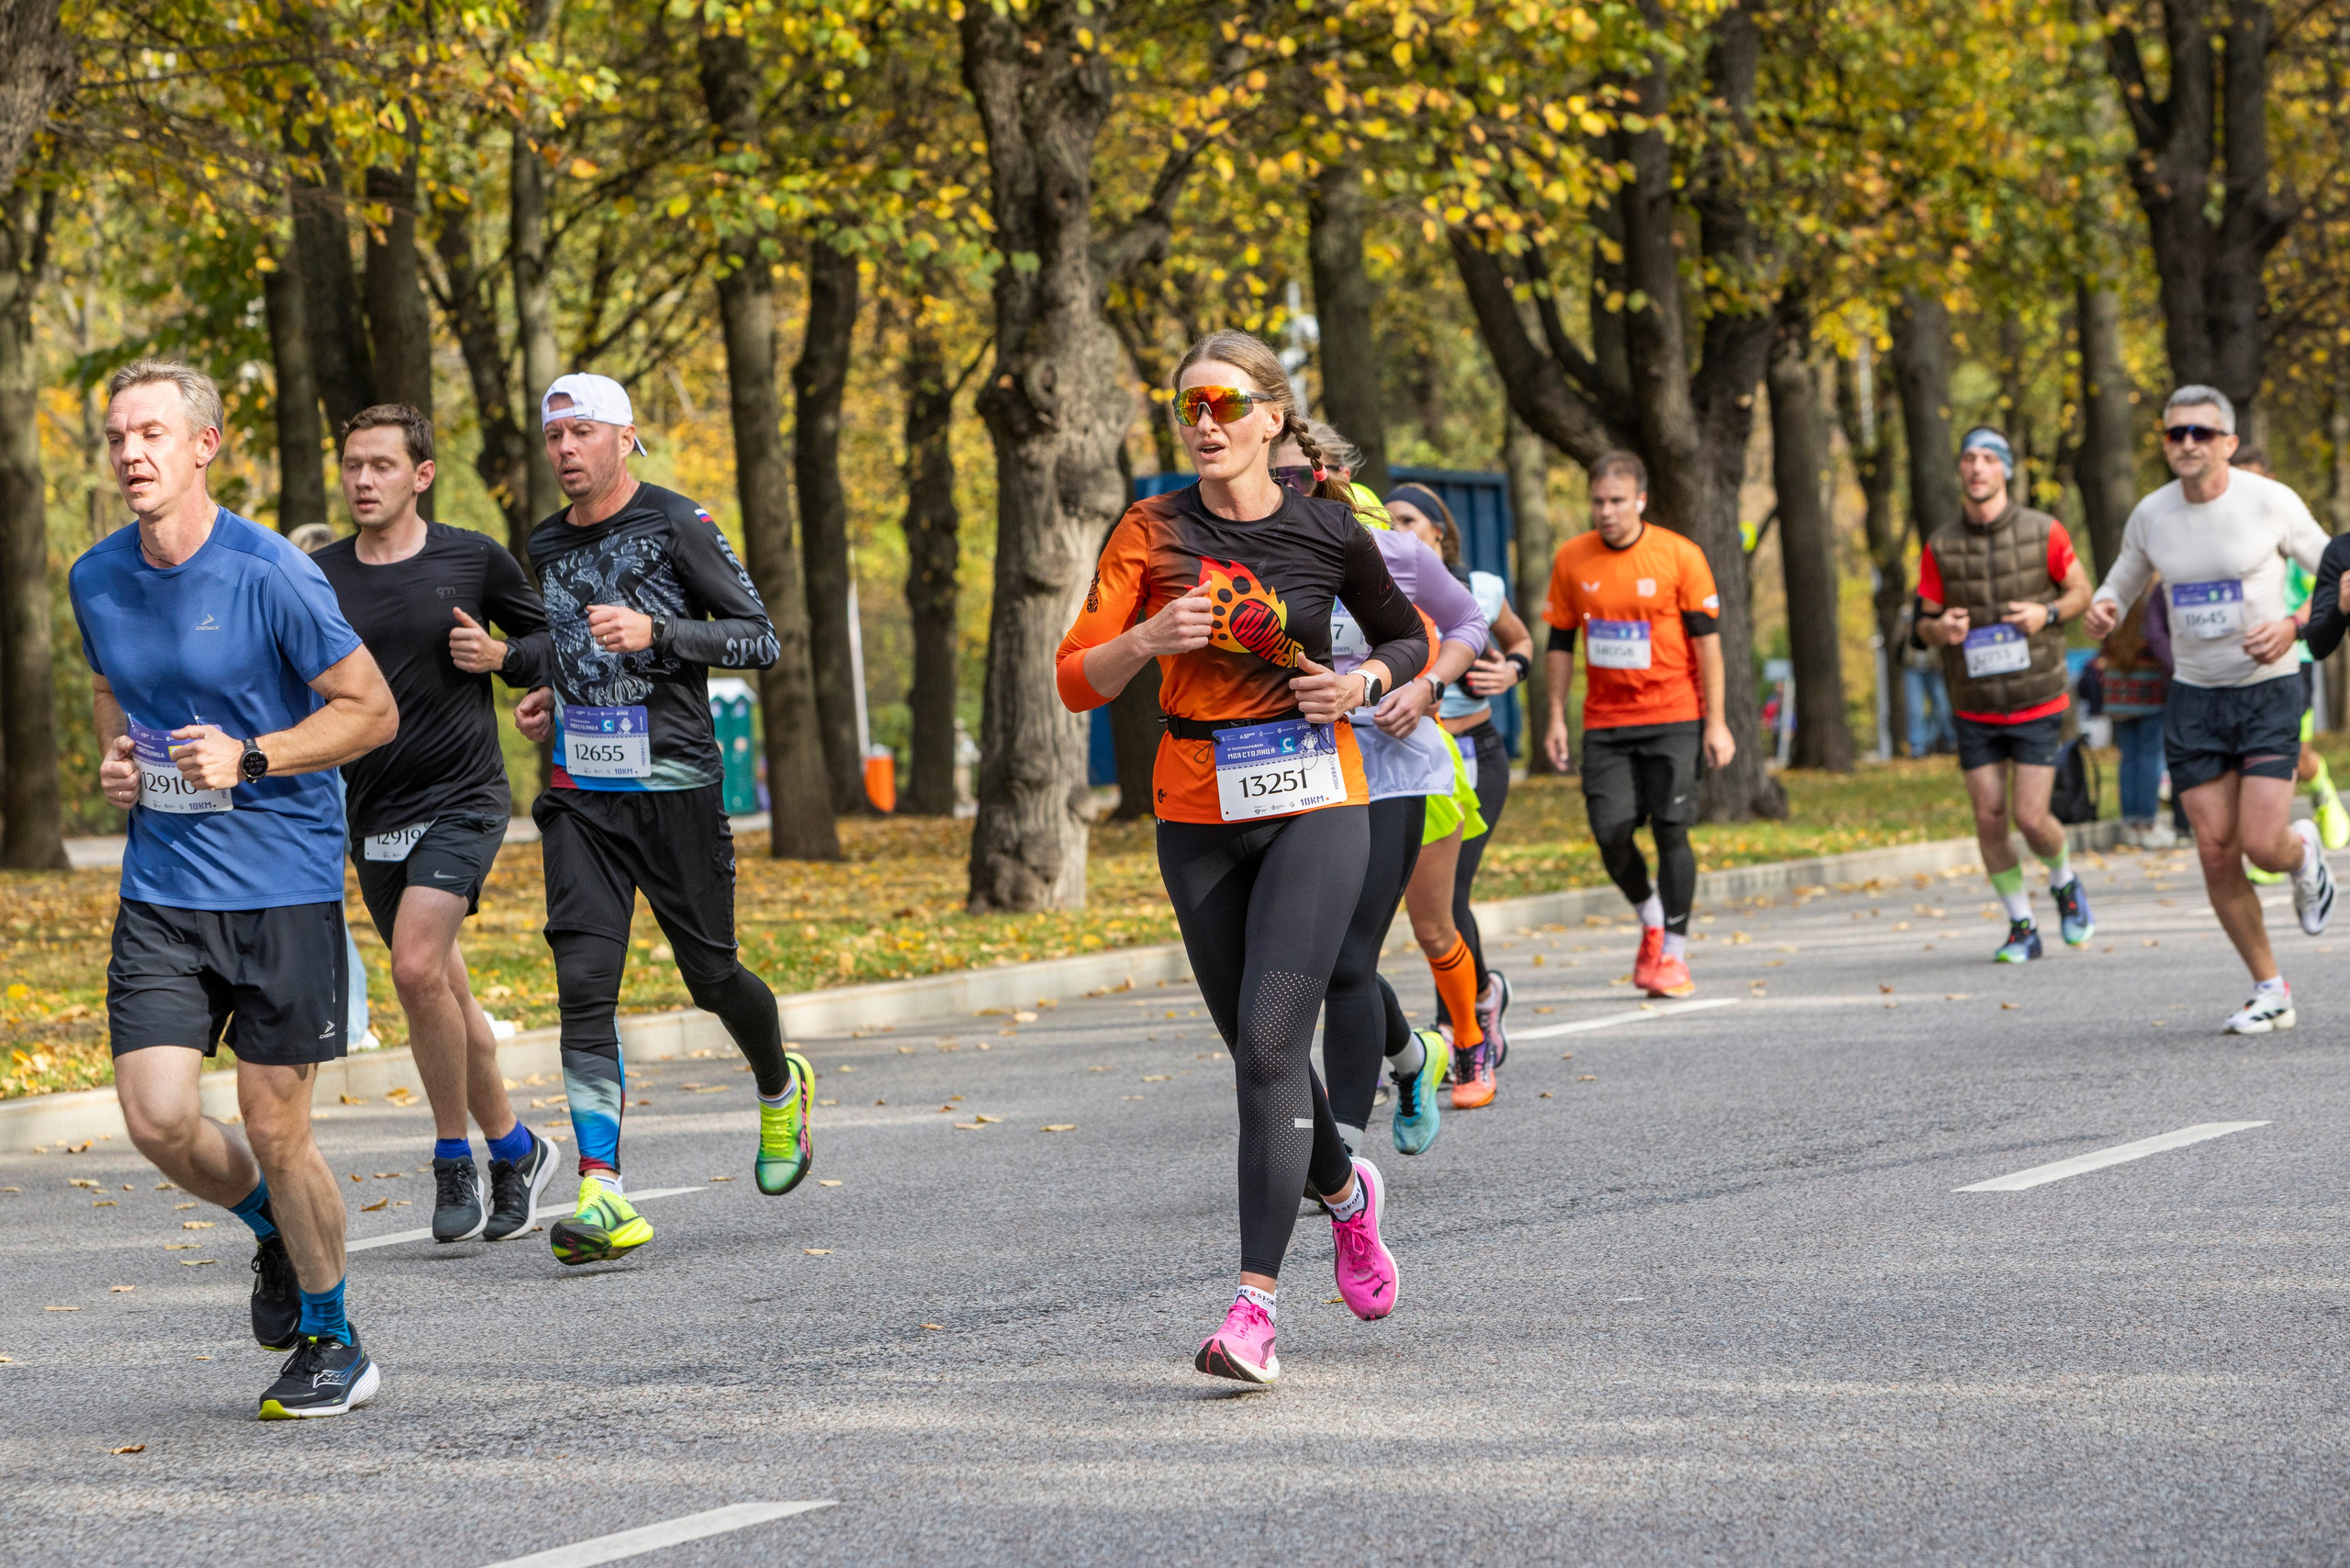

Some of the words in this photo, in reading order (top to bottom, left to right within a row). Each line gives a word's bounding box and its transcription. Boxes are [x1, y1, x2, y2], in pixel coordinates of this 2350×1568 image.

[574, 744, 624, 762] 12655
[1242, 747, 1276, 758] СТОЛИЦА
[1237, 767, 1308, 799] 13251
